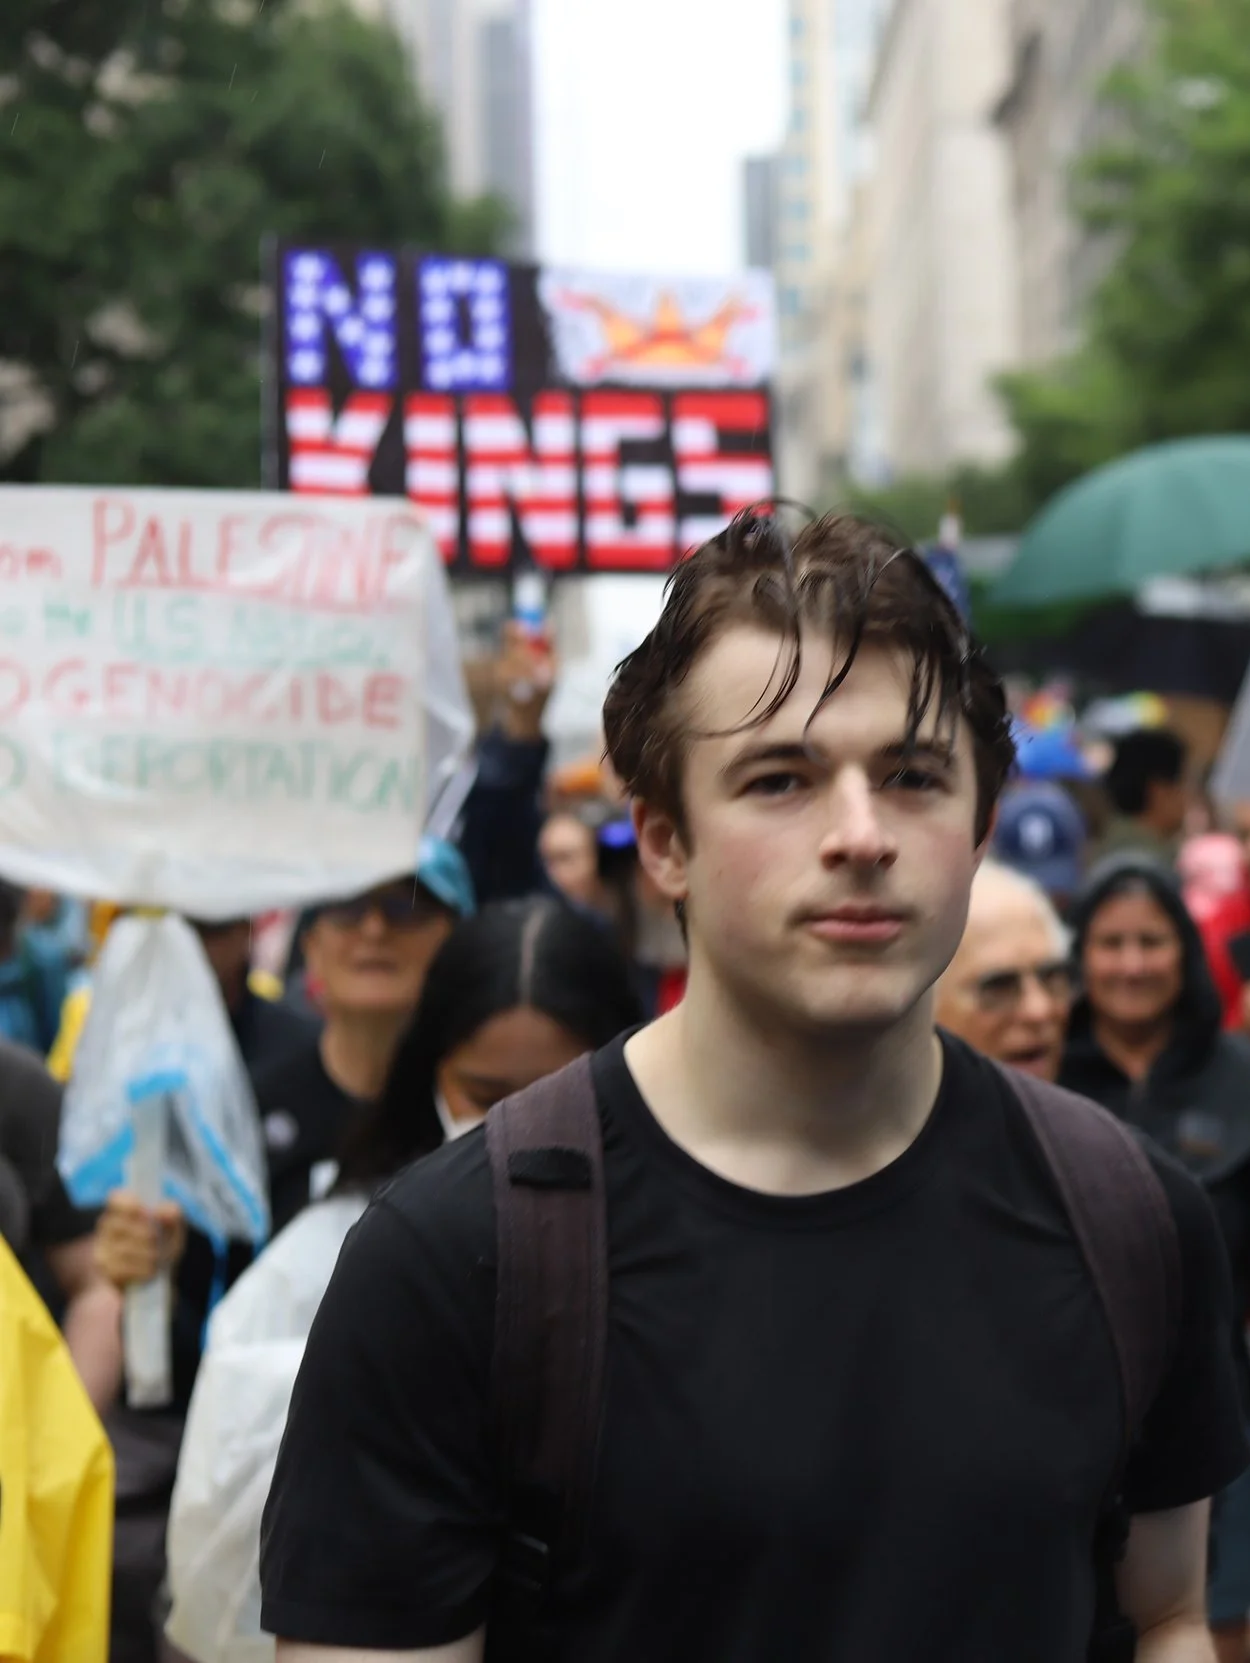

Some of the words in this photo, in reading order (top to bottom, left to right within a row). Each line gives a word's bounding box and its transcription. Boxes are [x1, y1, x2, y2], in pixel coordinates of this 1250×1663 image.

[284, 250, 510, 391] NO
[286, 388, 775, 570] KINGS
[90, 497, 425, 610] PALESTINE
[43, 657, 406, 731] GENOCIDE
[52, 731, 419, 815] DEPORTATION
